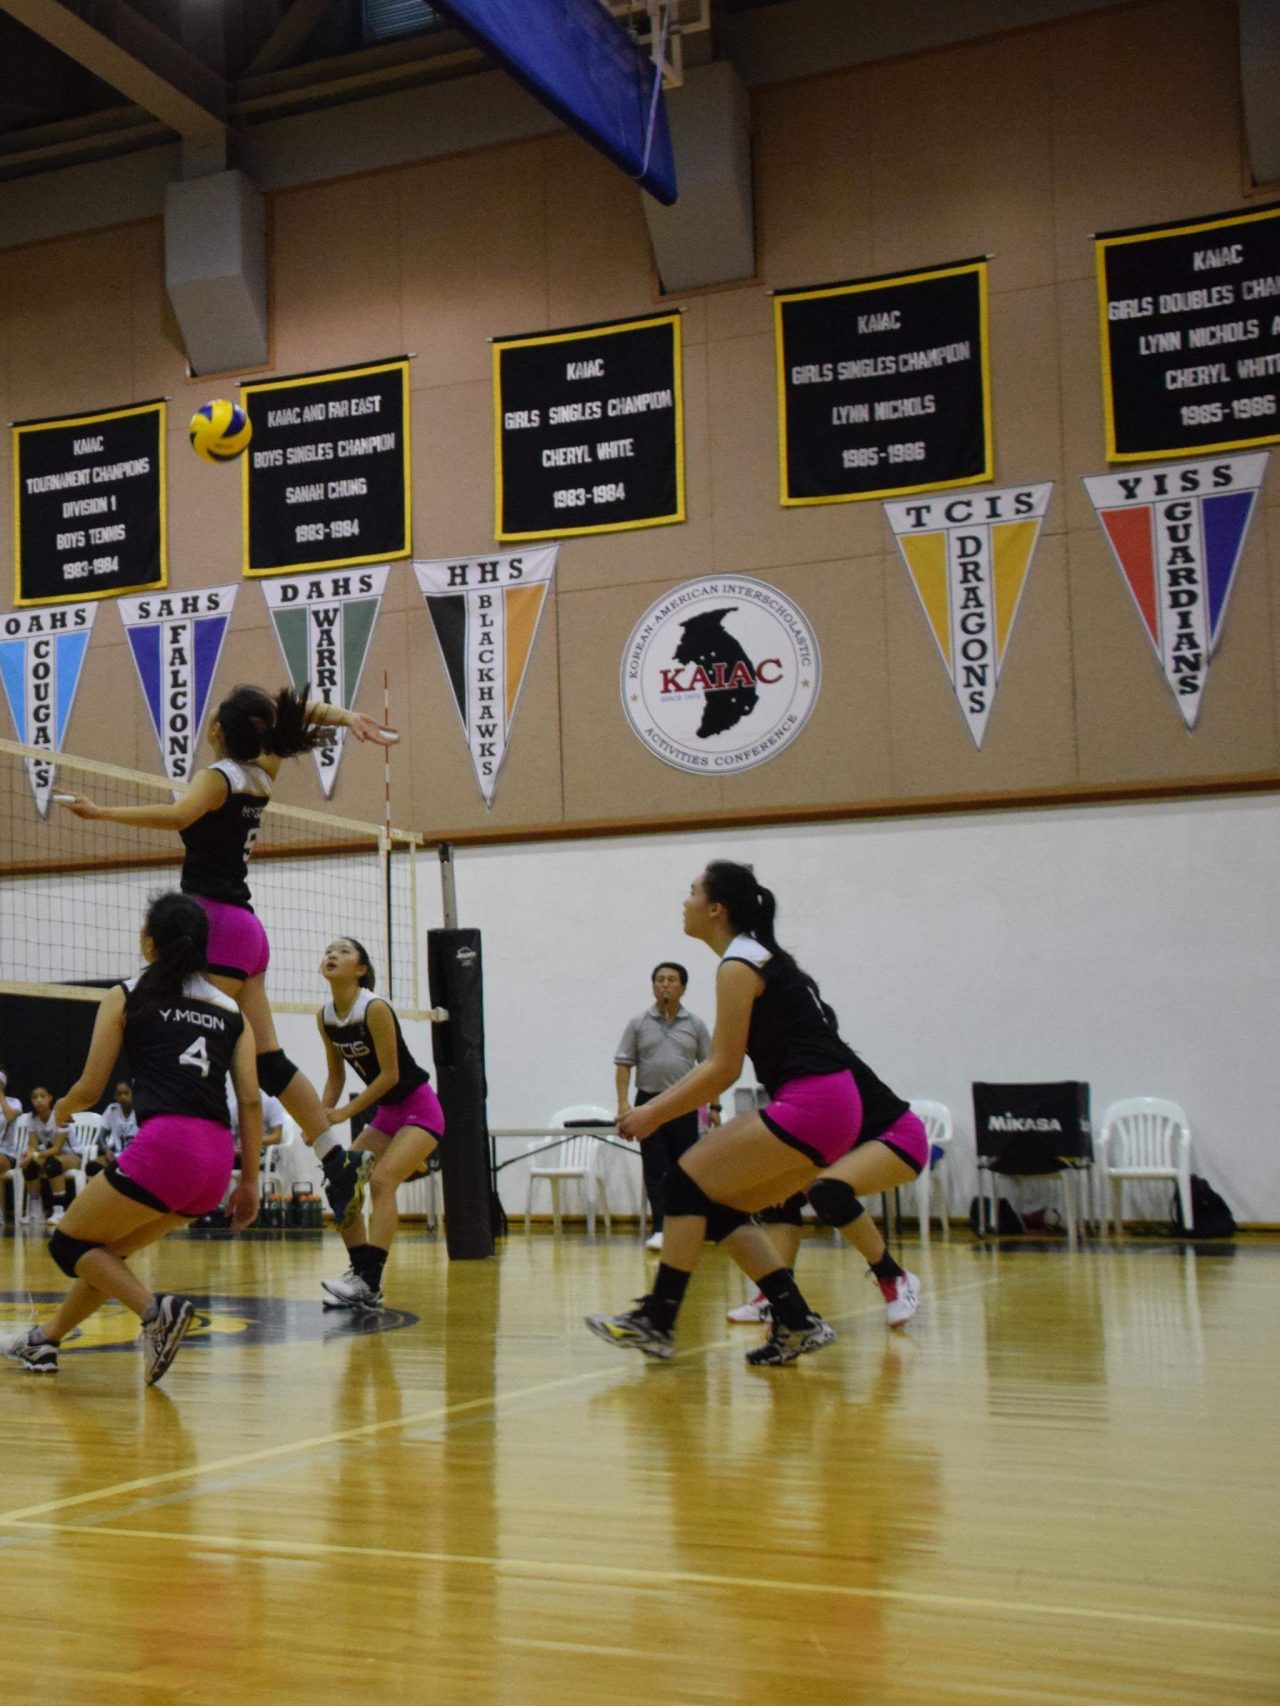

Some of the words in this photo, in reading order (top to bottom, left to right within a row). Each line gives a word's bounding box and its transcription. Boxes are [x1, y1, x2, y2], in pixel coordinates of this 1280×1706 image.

[1193, 244, 1244, 272] KAIAC
[1108, 297, 1153, 321] GIRLS
[1159, 285, 1234, 314] DOUBLES
[858, 310, 901, 334] KAIAC
[1139, 331, 1182, 355] LYNN
[1189, 319, 1260, 348] NICHOLS
[566, 358, 605, 381] KAIAC
[791, 363, 834, 385] GIRLS
[837, 356, 896, 381] SINGLES
[898, 341, 971, 373] CHAMPION
[1165, 363, 1231, 390] CHERYL
[267, 407, 301, 428] KAIAC
[303, 403, 325, 422] AND
[328, 400, 349, 419] FAR
[351, 395, 381, 416] EAST
[505, 409, 540, 429] GIRLS
[549, 401, 602, 425] SINGLES
[607, 389, 672, 417] CHAMPION
[832, 404, 869, 425] LYNN
[874, 394, 936, 421] NICHOLS
[1180, 395, 1276, 426] 1985-1986
[73, 436, 104, 456] KAIAC
[254, 449, 283, 469] BOYS
[286, 442, 333, 465] SINGLES
[338, 433, 395, 458] CHAMPION
[542, 445, 592, 468] CHERYL
[597, 438, 634, 461] WHITE
[842, 441, 926, 469] 1985-1986
[26, 468, 91, 494] TOURNAMENT
[92, 457, 150, 483] CHAMPIONS
[328, 478, 368, 499] CHUNG
[1119, 464, 1232, 499] YISS
[62, 497, 107, 519] DIVISION
[110, 495, 116, 511] 1
[553, 482, 625, 508] 1983-1984
[907, 492, 1034, 527] TCIS
[56, 531, 85, 550] BOYS
[88, 524, 126, 545] TENNIS
[295, 518, 359, 543] 1983-1984
[62, 556, 119, 580] 1983-1984
[448, 558, 523, 586] HHS
[281, 574, 372, 602] DAHS
[1165, 502, 1200, 694] GUARDIANS
[139, 593, 219, 619] SAHS
[5, 608, 86, 635] OAHS
[723, 584, 811, 666] INTERSCHOLASTIC
[957, 535, 988, 714] DRAGONS
[313, 608, 339, 767] WARRIRS
[477, 595, 497, 775] BLACKHAWKS
[660, 659, 782, 693] KAIAC
[170, 624, 188, 777] FALCONS
[645, 727, 708, 766] ACTIVITIES
[715, 714, 797, 766] CONFERENCE
[159, 1008, 224, 1031] Y.MOON
[179, 1036, 210, 1078] 4
[332, 1041, 370, 1057] TCIS
[354, 1060, 367, 1078] 1
